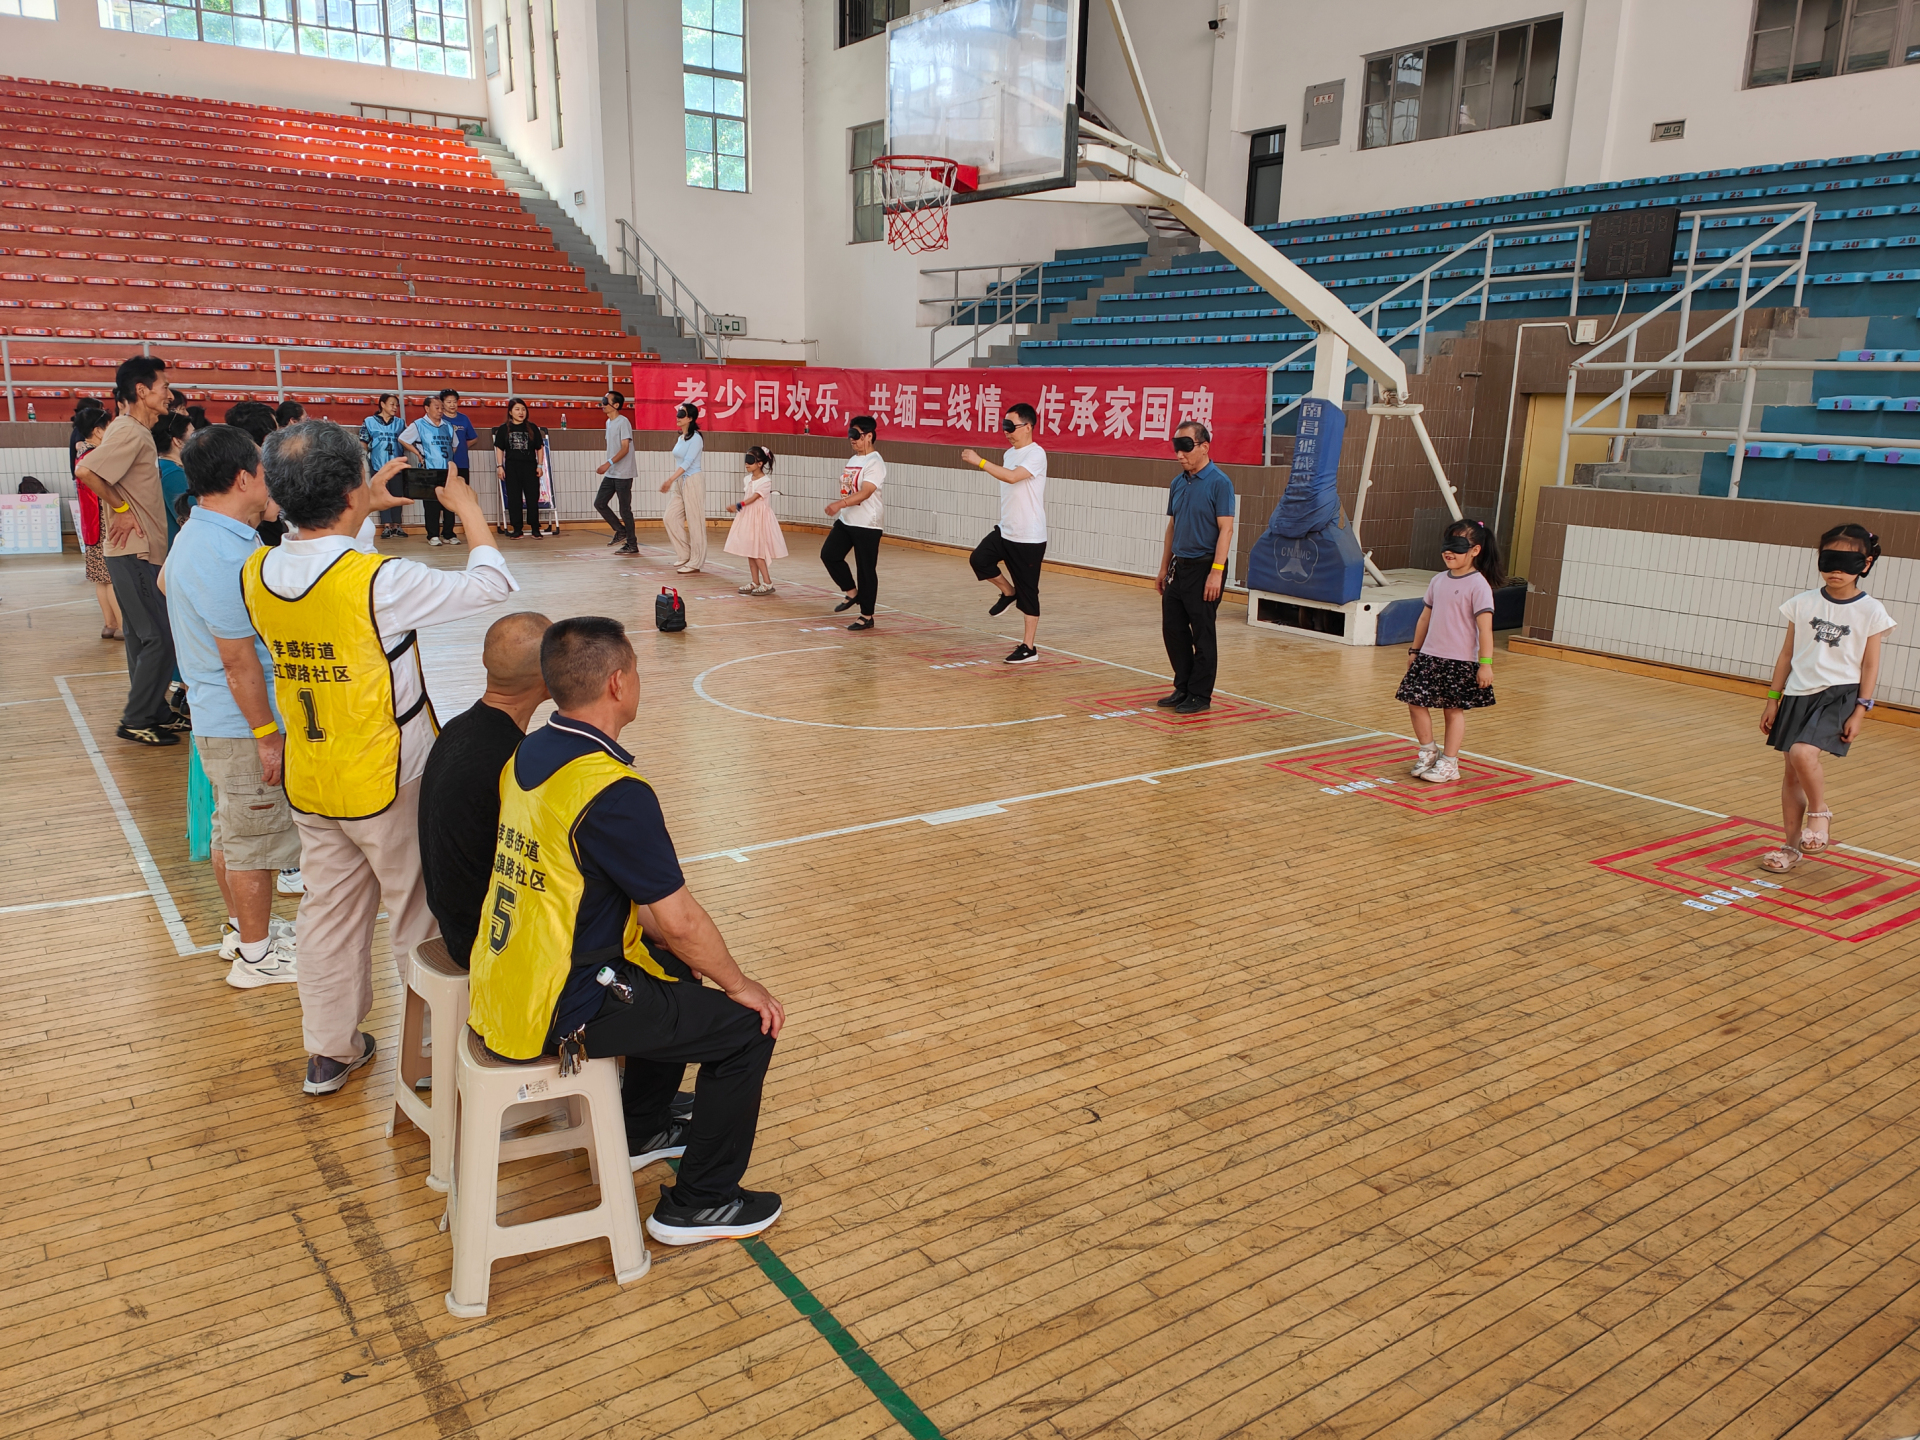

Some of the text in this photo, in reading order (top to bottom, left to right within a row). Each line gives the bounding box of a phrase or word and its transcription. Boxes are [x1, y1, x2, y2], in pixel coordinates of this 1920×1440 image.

[1663, 126, 1681, 134] 出口
[385, 443, 394, 455] 4
[440, 446, 449, 459] 5
[273, 639, 336, 660] 孝感街道
[297, 687, 327, 742] 1
[493, 851, 546, 892] 旗路社区
[489, 881, 517, 956] 5
